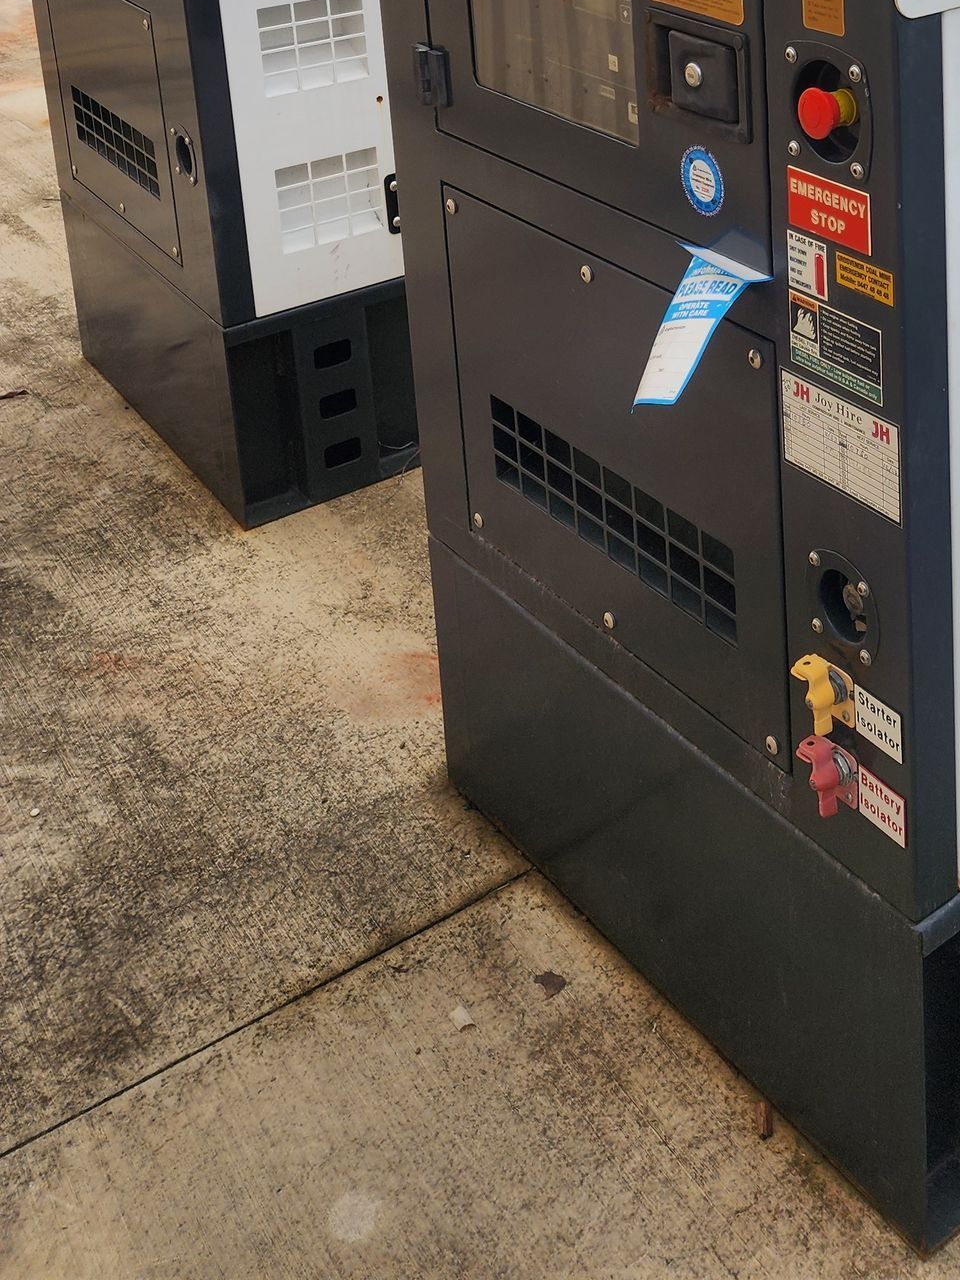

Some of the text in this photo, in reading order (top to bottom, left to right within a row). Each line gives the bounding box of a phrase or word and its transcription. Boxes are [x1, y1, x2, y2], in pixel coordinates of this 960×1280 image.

[790, 177, 866, 218] EMERGENCY
[810, 209, 845, 234] STOP
[795, 234, 806, 246] CASE
[808, 240, 814, 248] OF
[815, 242, 825, 253] FIRE
[678, 280, 738, 298] PLEASE READ
[679, 301, 711, 311] OPERATE
[793, 380, 810, 404] JH
[815, 393, 832, 411] Joy
[836, 402, 863, 425] Hire
[872, 420, 890, 445] JH
[858, 691, 897, 729] Starter
[856, 711, 900, 752] Isolator
[861, 772, 901, 815] Battery
[860, 792, 903, 836] Isolator
